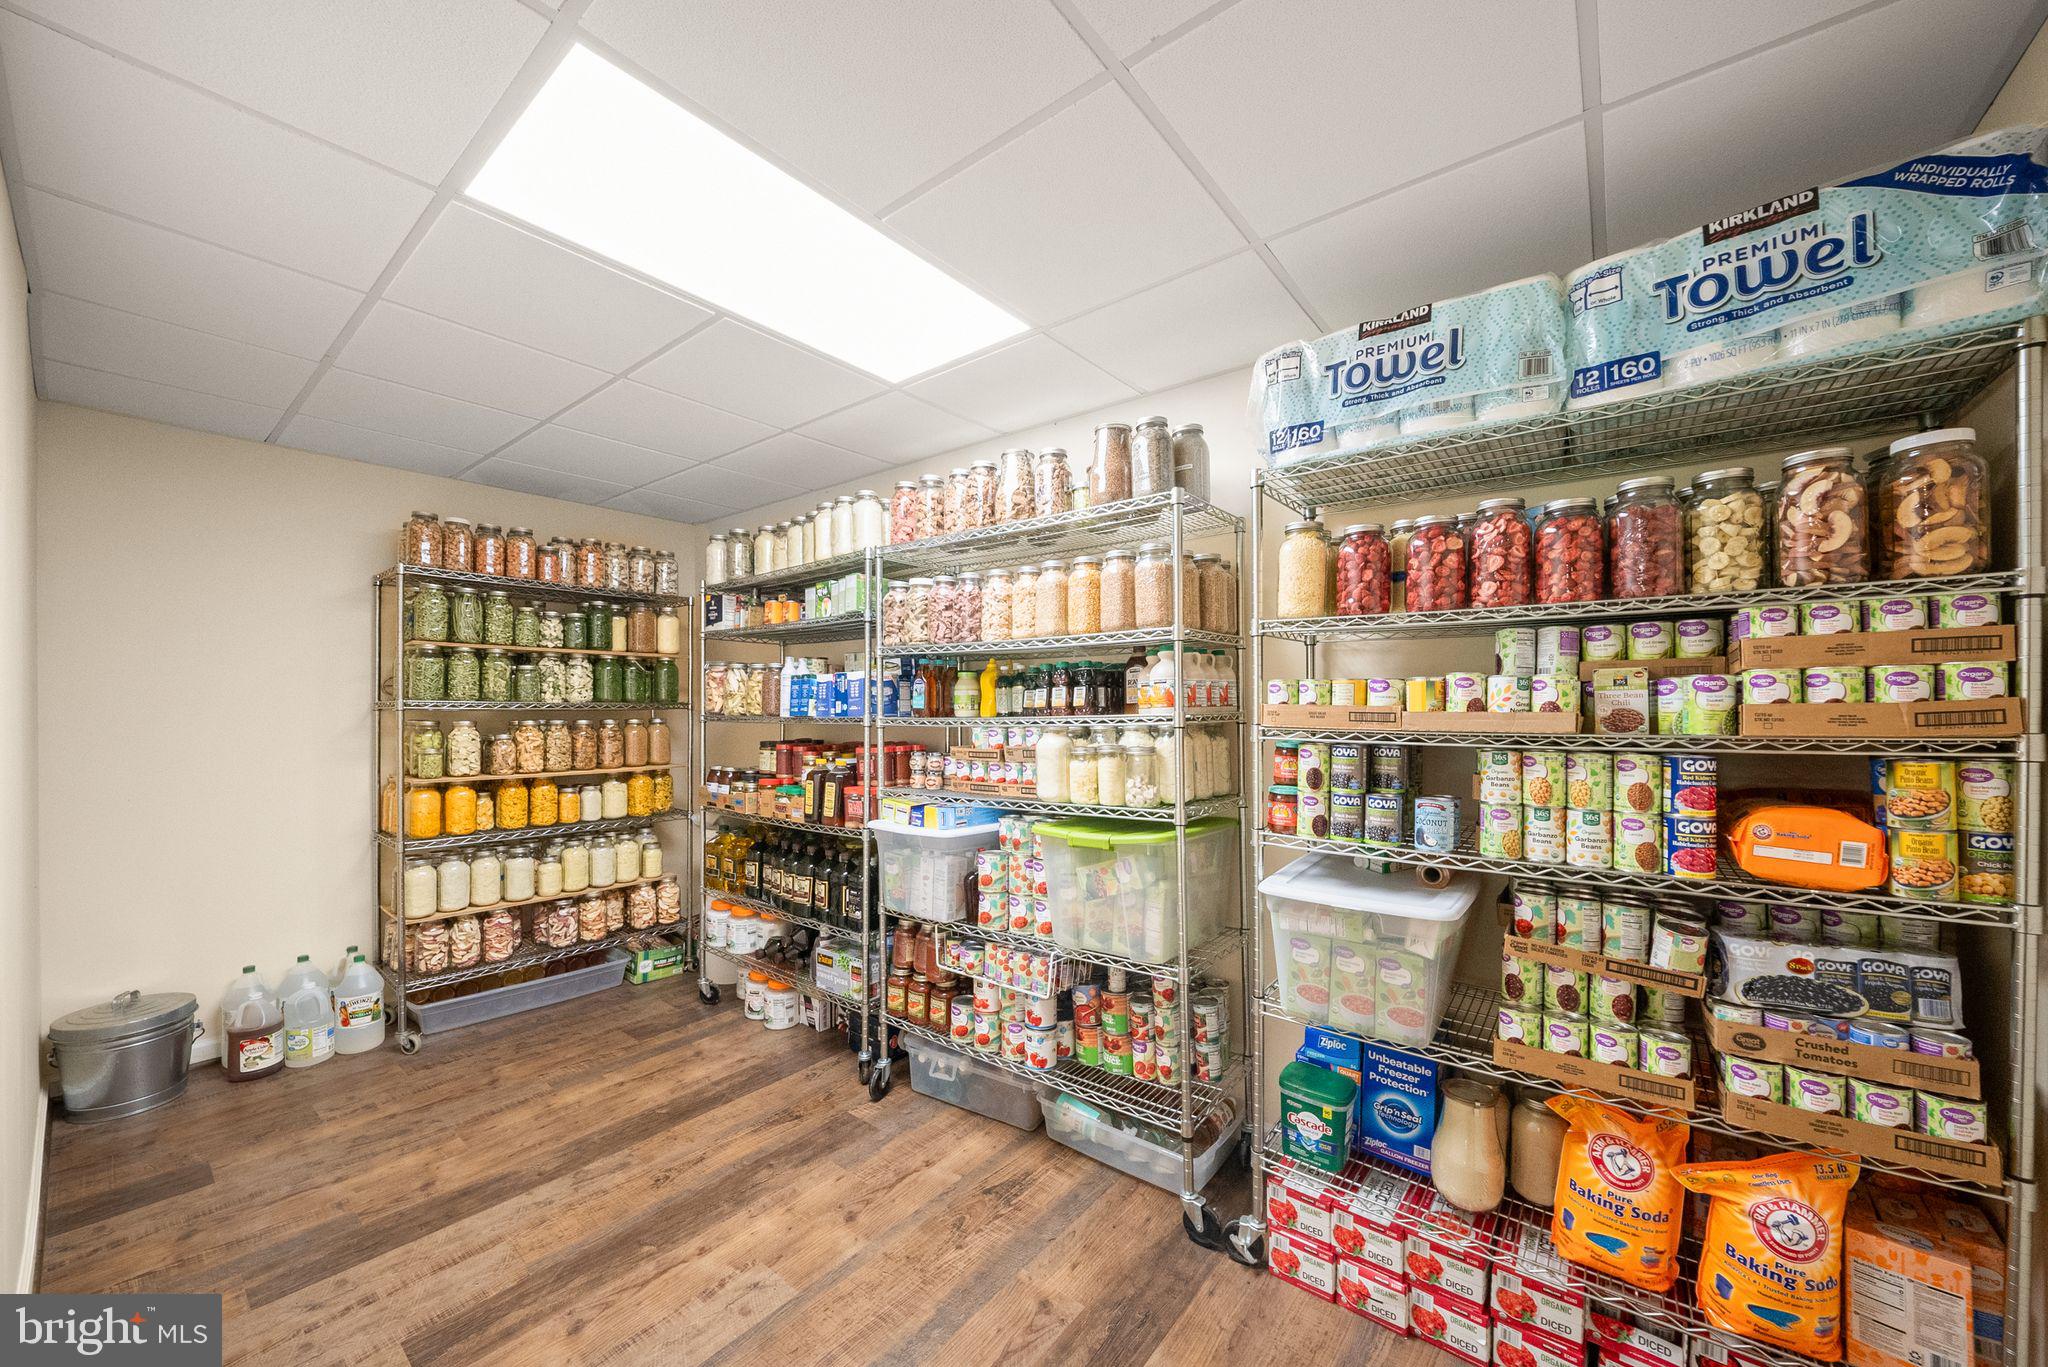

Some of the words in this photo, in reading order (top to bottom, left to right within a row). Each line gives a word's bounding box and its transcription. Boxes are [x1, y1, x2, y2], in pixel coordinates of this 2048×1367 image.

[1910, 163, 2012, 177] INDIVIDUALLY
[1894, 172, 1967, 187] WRAPPED
[1970, 175, 2016, 188] ROLLS
[1709, 191, 1815, 234] KIRKLAND
[1703, 224, 1818, 271] PREMIUM
[1653, 214, 1877, 320] Towel
[1690, 314, 1728, 330] Strong,
[1732, 305, 1760, 317] Thick
[1763, 298, 1784, 308] and
[1789, 279, 1848, 301] Absorbent
[1356, 332, 1431, 360] PREMIUM
[1727, 346, 1738, 357] SQ
[1325, 327, 1464, 398] Towel
[1610, 357, 1656, 380] 160
[1576, 370, 1599, 388] 12
[1631, 375, 1642, 383] PER
[1642, 371, 1656, 380] ROLL
[1370, 390, 1389, 400] Thick
[1391, 387, 1404, 396] and
[1406, 376, 1444, 393] Absorbent
[1576, 384, 1600, 394] ROLLS
[1883, 602, 1912, 613] Organic
[1955, 598, 1984, 607] Organic
[1763, 611, 1787, 620] Organic
[1811, 608, 1840, 618] Organic
[1585, 628, 1610, 637] Organic
[1633, 626, 1661, 634] Organic
[1679, 624, 1706, 632] Organic
[1750, 677, 1775, 686] Organic
[1887, 674, 1918, 683] Organic
[1960, 670, 1993, 679] Organic
[1694, 679, 1725, 687] Organic
[1333, 748, 1358, 756] GOYA
[1374, 748, 1401, 756] GOYA
[1493, 754, 1507, 762] 365
[1900, 776, 1914, 784] Pinto
[1916, 776, 1934, 785] Beans
[1904, 769, 1927, 778] Organic
[1961, 772, 1990, 780] Organic
[1334, 795, 1361, 806] GOYA
[1368, 798, 1397, 809] GOYA
[1416, 816, 1448, 827] COCONUT
[1528, 831, 1558, 839] Garbanzo
[1575, 836, 1607, 844] Garbanzo
[1911, 838, 1934, 847] Organic
[1906, 844, 1921, 854] Pinto
[1922, 846, 1940, 855] Beans
[1772, 911, 1799, 920] Organic
[1861, 960, 1906, 976] GOYA
[1913, 968, 1950, 982] GOYA
[1320, 1036, 1347, 1050] Ziploc
[1736, 1034, 1760, 1045] Great
[1795, 1038, 1849, 1055] Crushed
[1656, 1049, 1680, 1058] Organic
[1794, 1049, 1858, 1069] Tomatoes
[1368, 1050, 1432, 1077] Unbeatable
[1378, 1064, 1420, 1084] Freezer
[1732, 1066, 1756, 1078] Organic
[1369, 1072, 1427, 1097] Protection
[1801, 1081, 1828, 1093] Organic
[1867, 1094, 1899, 1106] Organic
[1373, 1101, 1401, 1119] Grip'n
[1399, 1110, 1422, 1124] Seal
[1377, 1111, 1418, 1129] Technology
[1940, 1109, 1973, 1121] Organic
[1287, 1112, 1332, 1136] Cascade
[1364, 1136, 1388, 1149] Ziploc
[1592, 1137, 1605, 1158] ARM
[1380, 1148, 1403, 1161] GALLON
[1404, 1156, 1429, 1169] FREEZER
[1813, 1163, 1834, 1175] 13.5
[1836, 1163, 1848, 1172] lb
[1569, 1178, 1624, 1218] Baking
[1631, 1207, 1669, 1223] Soda
[1607, 1190, 1633, 1205] Pure
[1300, 1204, 1322, 1219] ORGANIC
[1783, 1199, 1826, 1241] HAMMER
[1300, 1222, 1323, 1237] DICED
[1368, 1232, 1393, 1248] ORGANIC
[1303, 1255, 1325, 1270] ORGANIC
[1368, 1250, 1393, 1266] DICED
[1447, 1260, 1475, 1277] ORGANIC
[1725, 1243, 1798, 1291] Baking
[1775, 1261, 1807, 1277] Pure
[1303, 1271, 1325, 1287] DICED
[1373, 1286, 1399, 1301] ORGANIC
[1446, 1278, 1473, 1296] DICED
[1371, 1305, 1397, 1321] DICED
[1541, 1298, 1572, 1315] ORGANIC
[1450, 1316, 1478, 1335] ORGANIC
[1541, 1317, 1572, 1335] DICED
[1450, 1335, 1478, 1354] DICED
[1638, 1335, 1672, 1357] DICED
